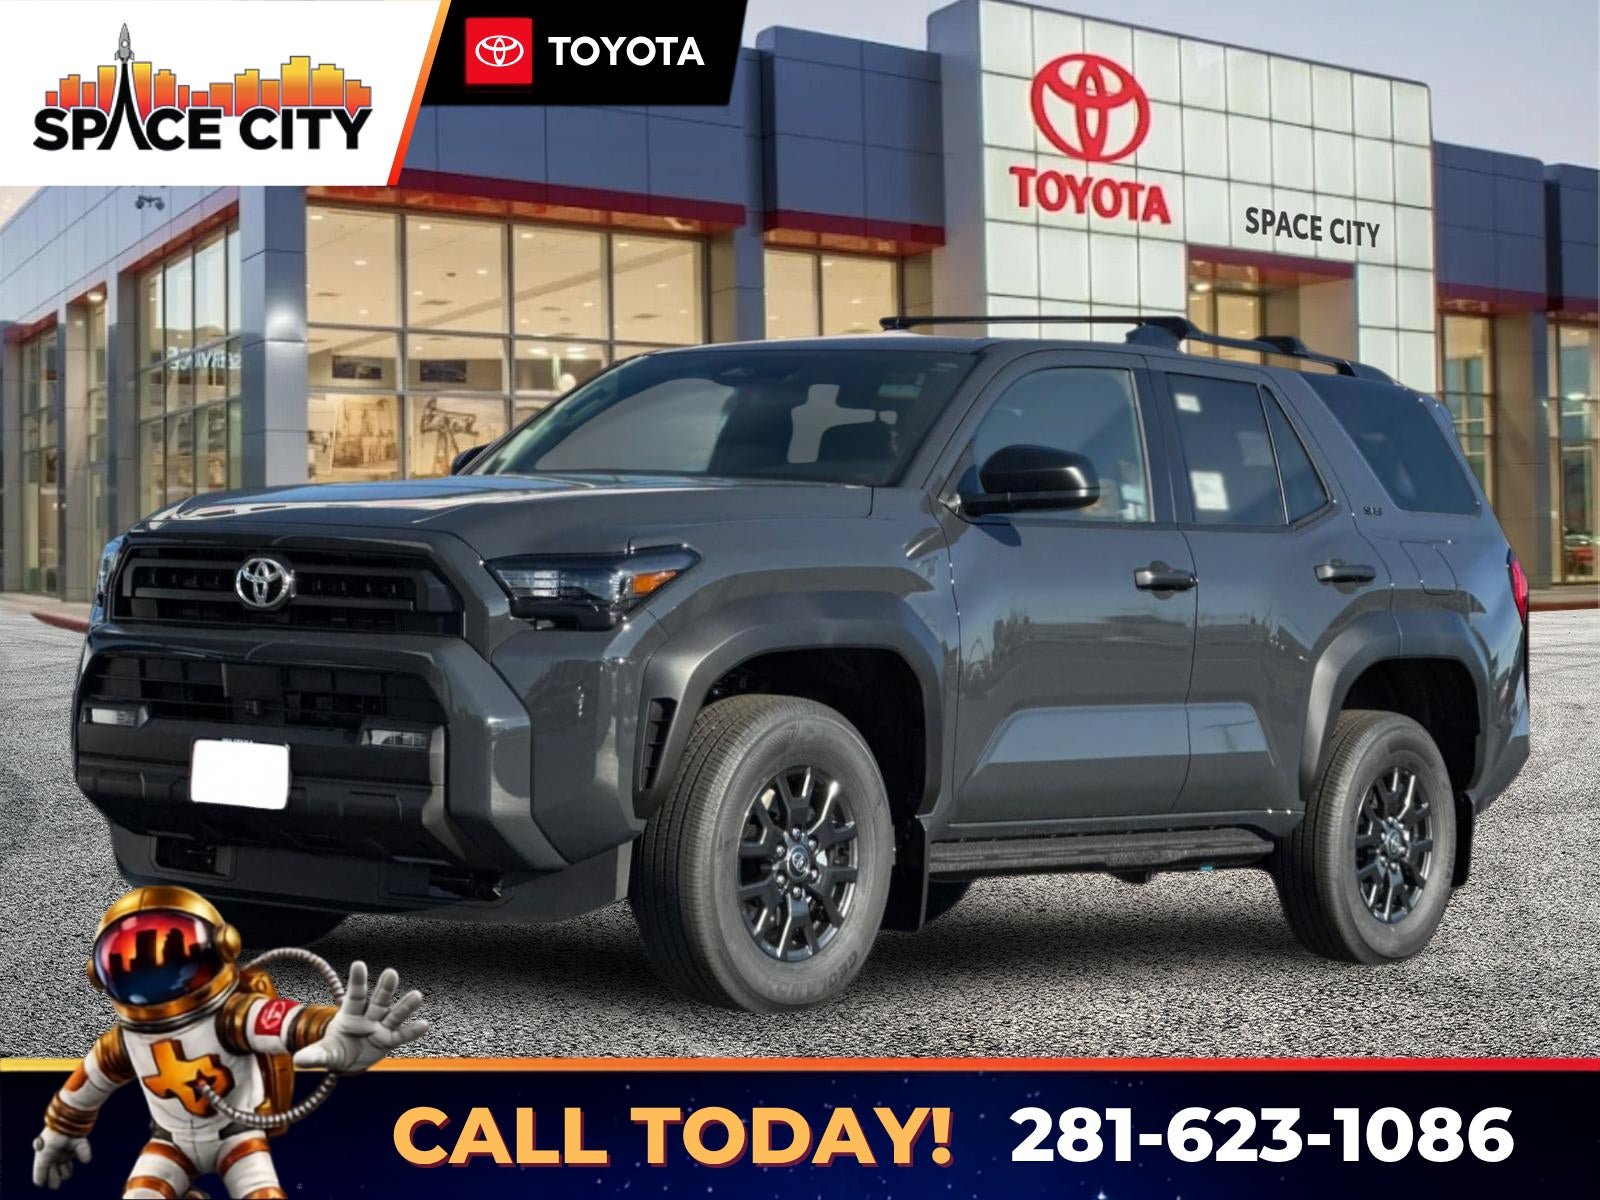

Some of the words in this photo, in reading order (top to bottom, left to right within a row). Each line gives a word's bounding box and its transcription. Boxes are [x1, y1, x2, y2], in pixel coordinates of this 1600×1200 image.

[1009, 166, 1171, 224] TOYOTA
[1245, 206, 1323, 241] SPACE
[1329, 217, 1381, 248] CITY
